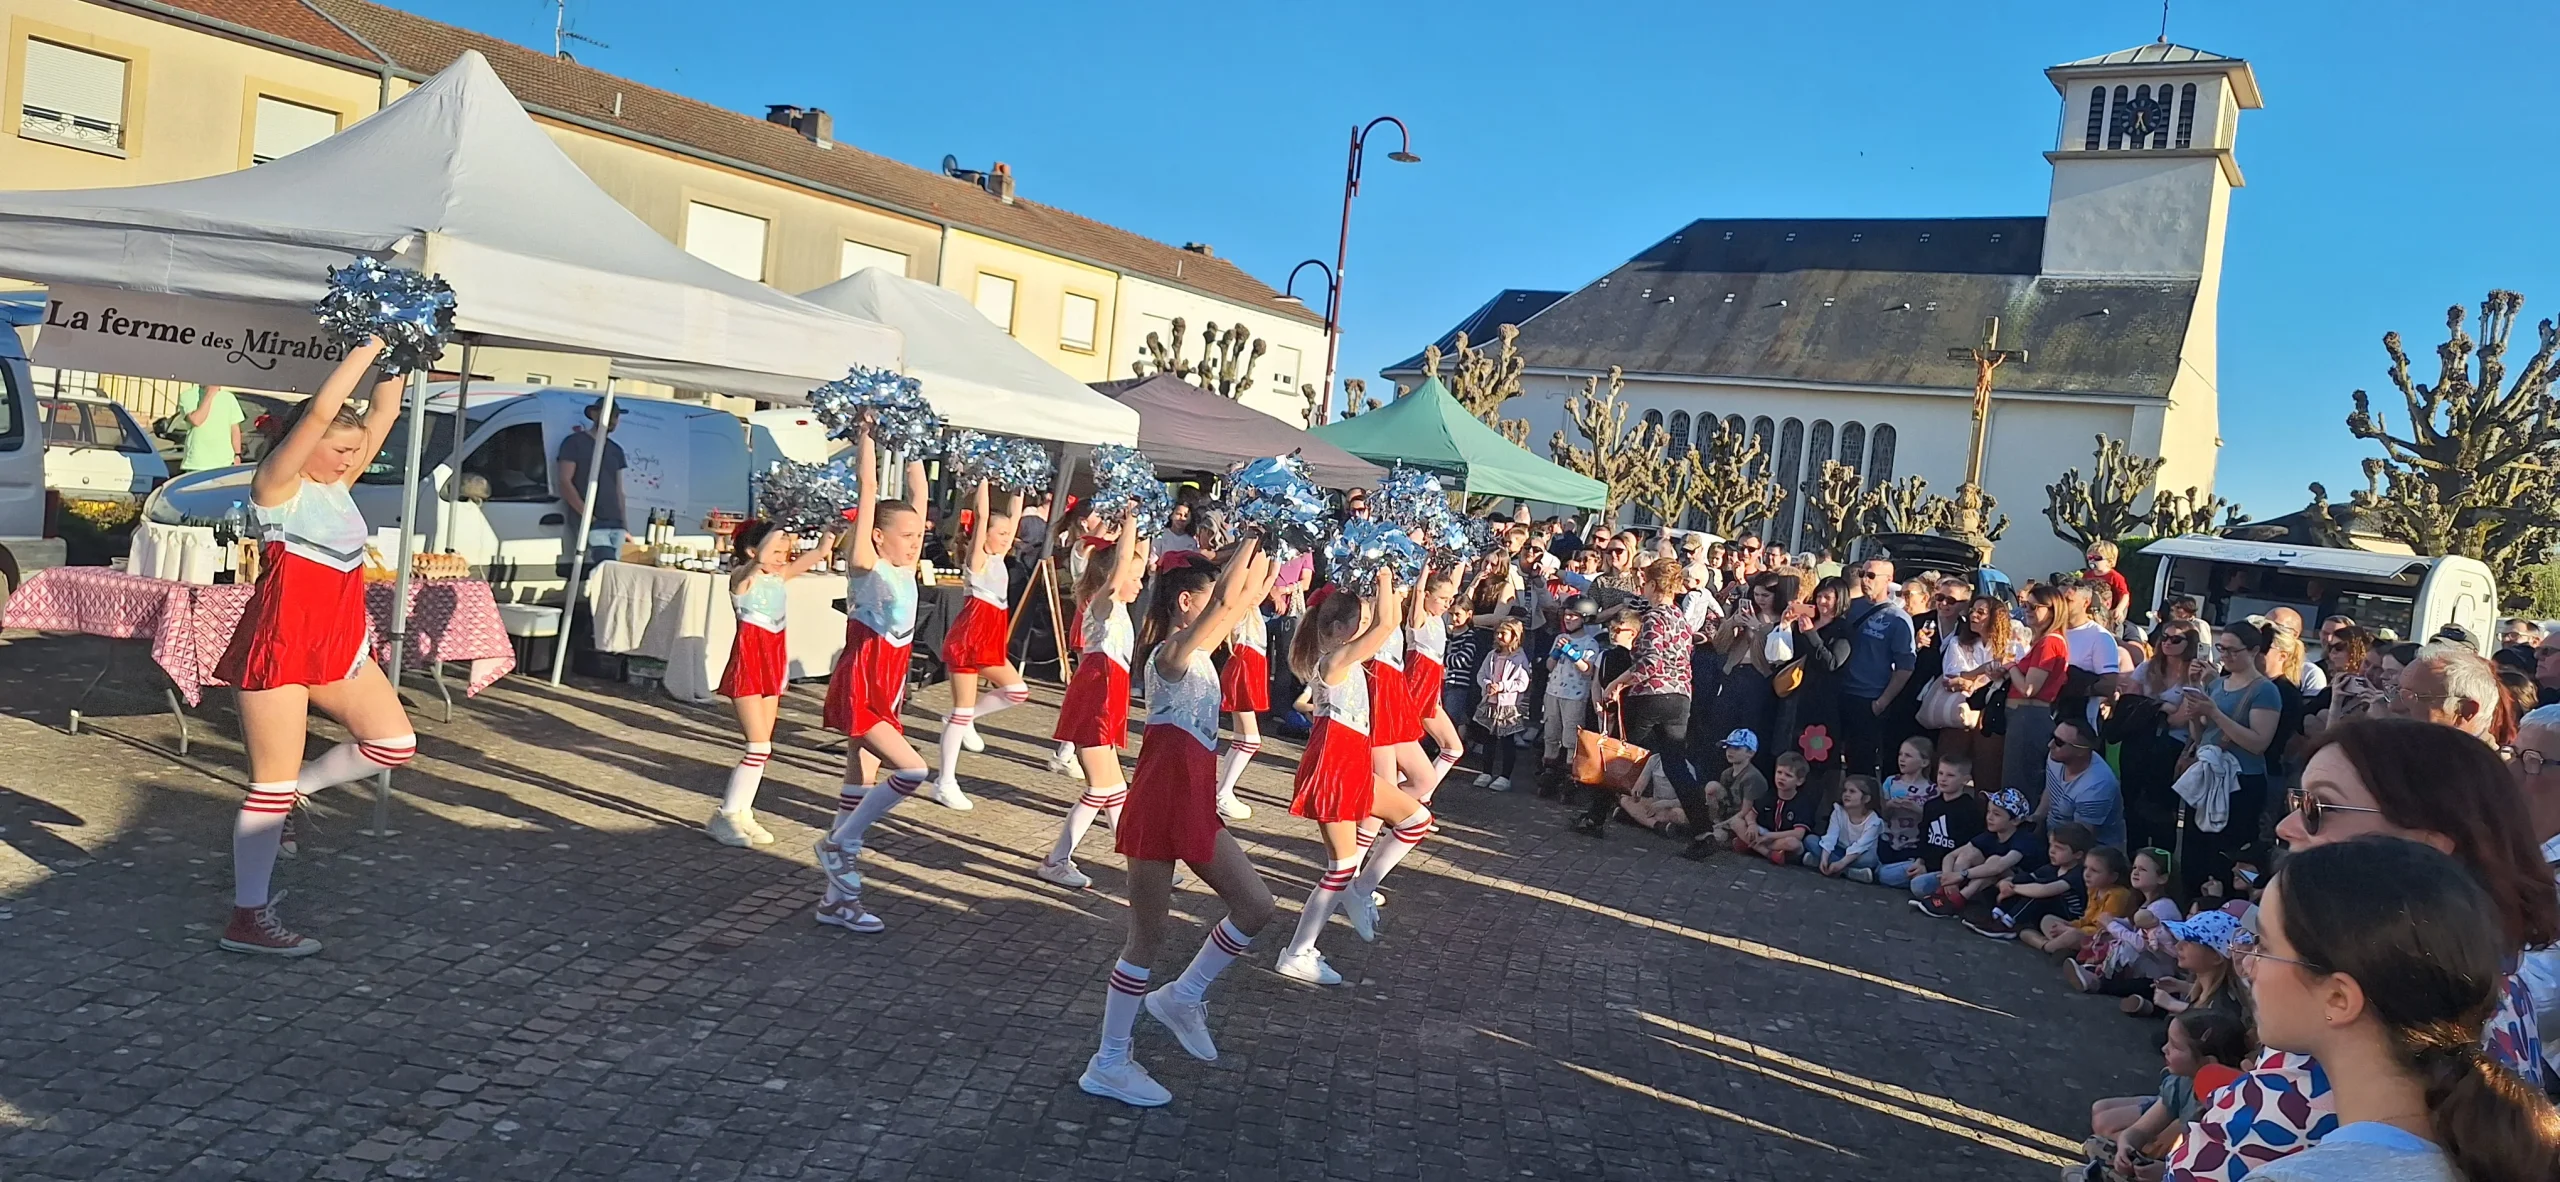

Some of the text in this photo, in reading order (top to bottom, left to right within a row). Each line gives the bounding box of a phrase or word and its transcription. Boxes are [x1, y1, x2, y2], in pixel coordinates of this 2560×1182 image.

[46, 300, 343, 370] La ferme des Mirabel
[1927, 831, 1955, 848] idas
